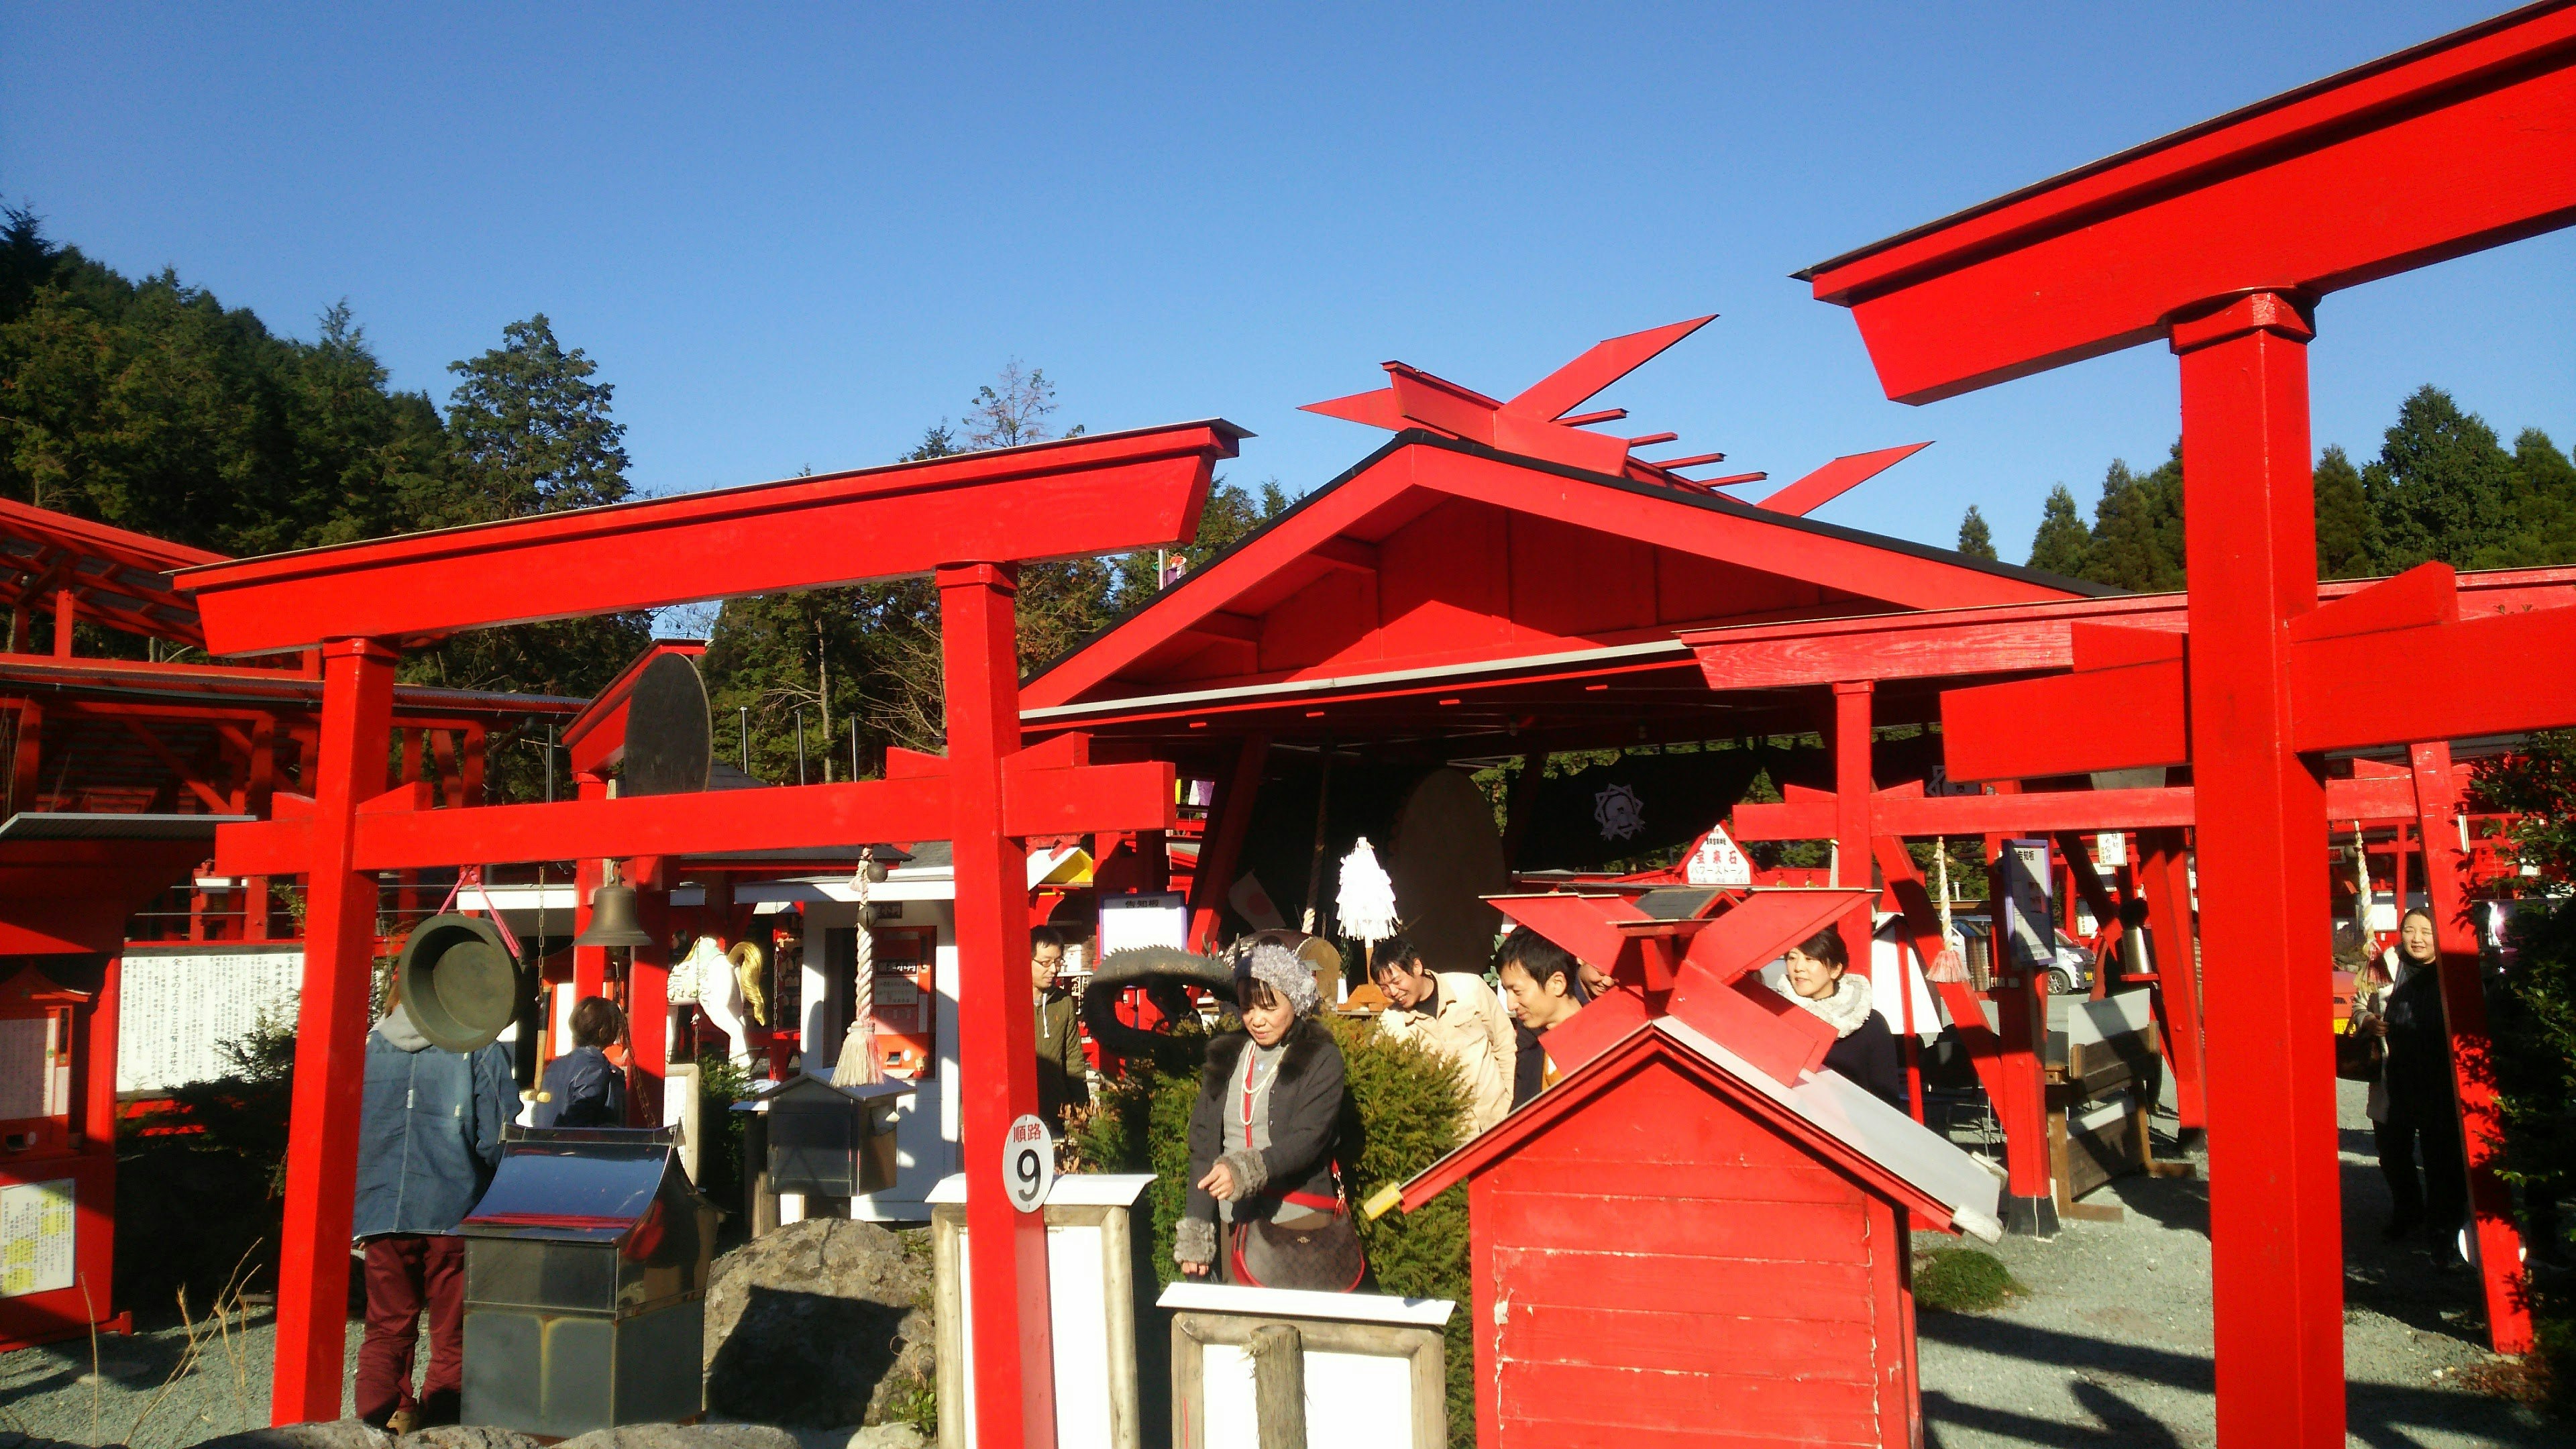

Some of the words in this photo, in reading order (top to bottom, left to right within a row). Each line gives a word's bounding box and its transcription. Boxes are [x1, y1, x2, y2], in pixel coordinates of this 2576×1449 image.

[1125, 899, 1159, 908] 告知板
[1013, 1122, 1041, 1143] 順路
[1016, 1148, 1041, 1201] 9
